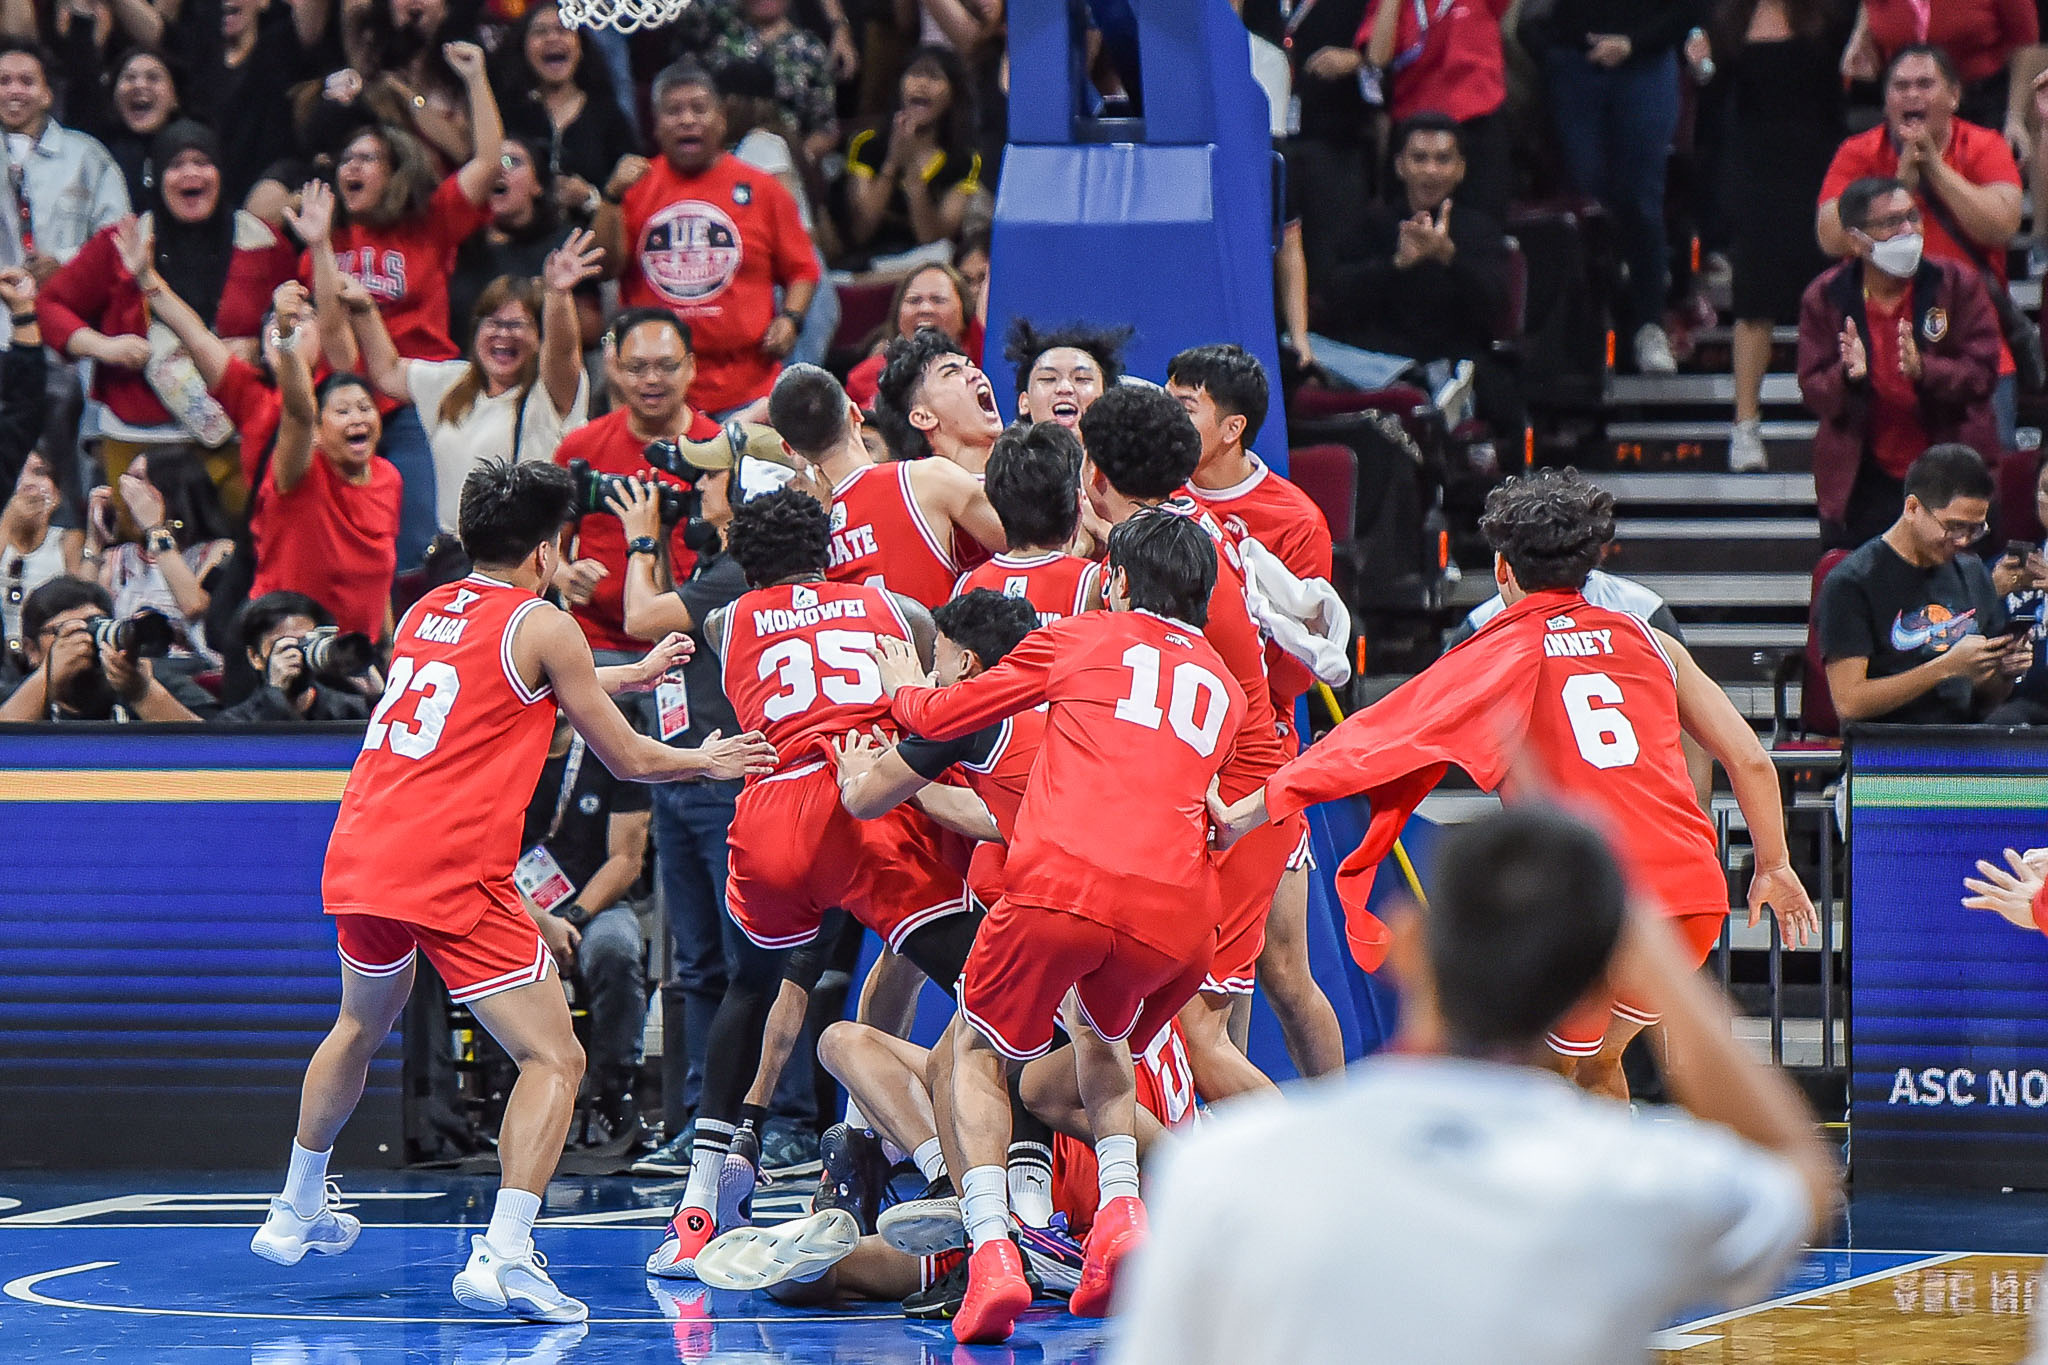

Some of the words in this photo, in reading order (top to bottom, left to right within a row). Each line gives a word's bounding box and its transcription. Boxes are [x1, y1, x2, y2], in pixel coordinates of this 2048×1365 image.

[414, 612, 469, 645] MAGA
[753, 599, 867, 638] MOMOWEI
[361, 656, 461, 760] 23
[757, 629, 884, 722] 35
[1114, 642, 1231, 759] 10
[1561, 672, 1641, 770] 6
[1887, 1067, 1977, 1107] ASC
